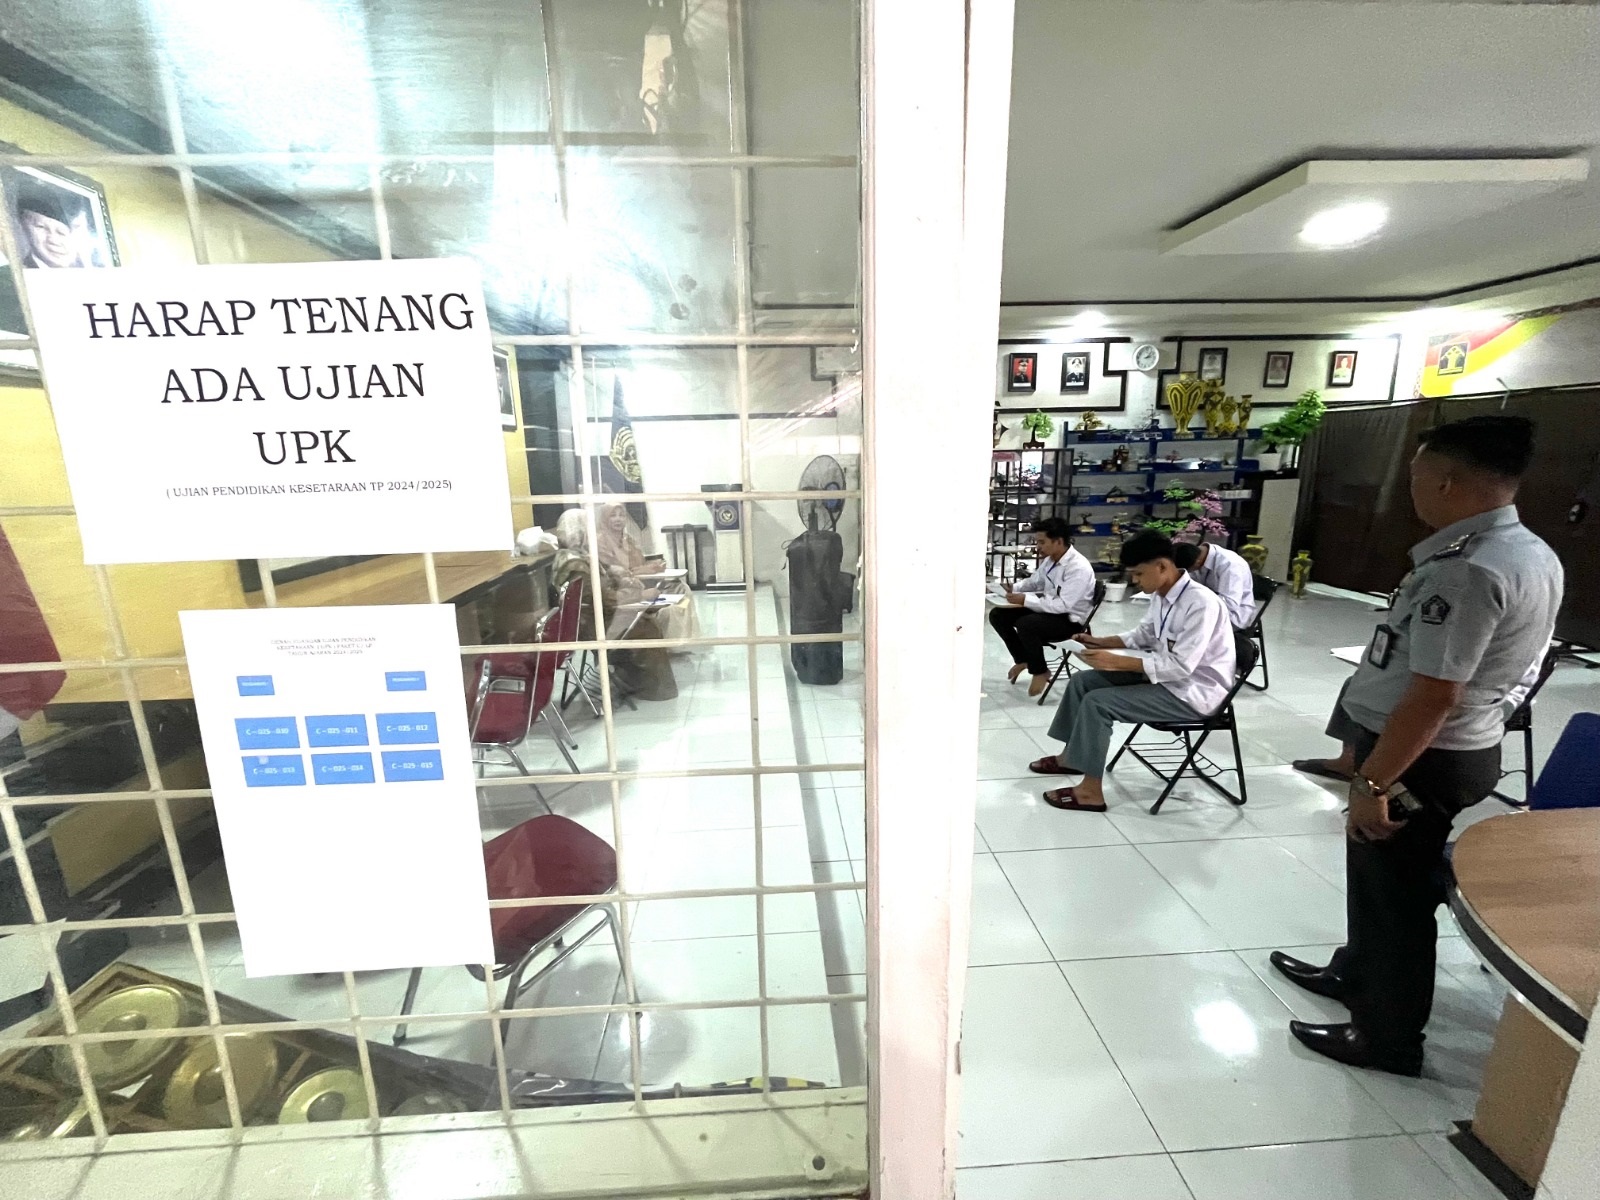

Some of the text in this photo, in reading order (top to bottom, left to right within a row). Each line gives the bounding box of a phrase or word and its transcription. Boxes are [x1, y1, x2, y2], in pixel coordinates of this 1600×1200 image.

[83, 293, 474, 338] HARAP TENANG
[161, 363, 424, 403] ADA UJIAN
[253, 430, 356, 465] UPK
[173, 487, 208, 496] UJIAN
[213, 485, 285, 495] PENDIDIKAN
[289, 482, 366, 493] KESETARAAN
[370, 482, 384, 491] TP
